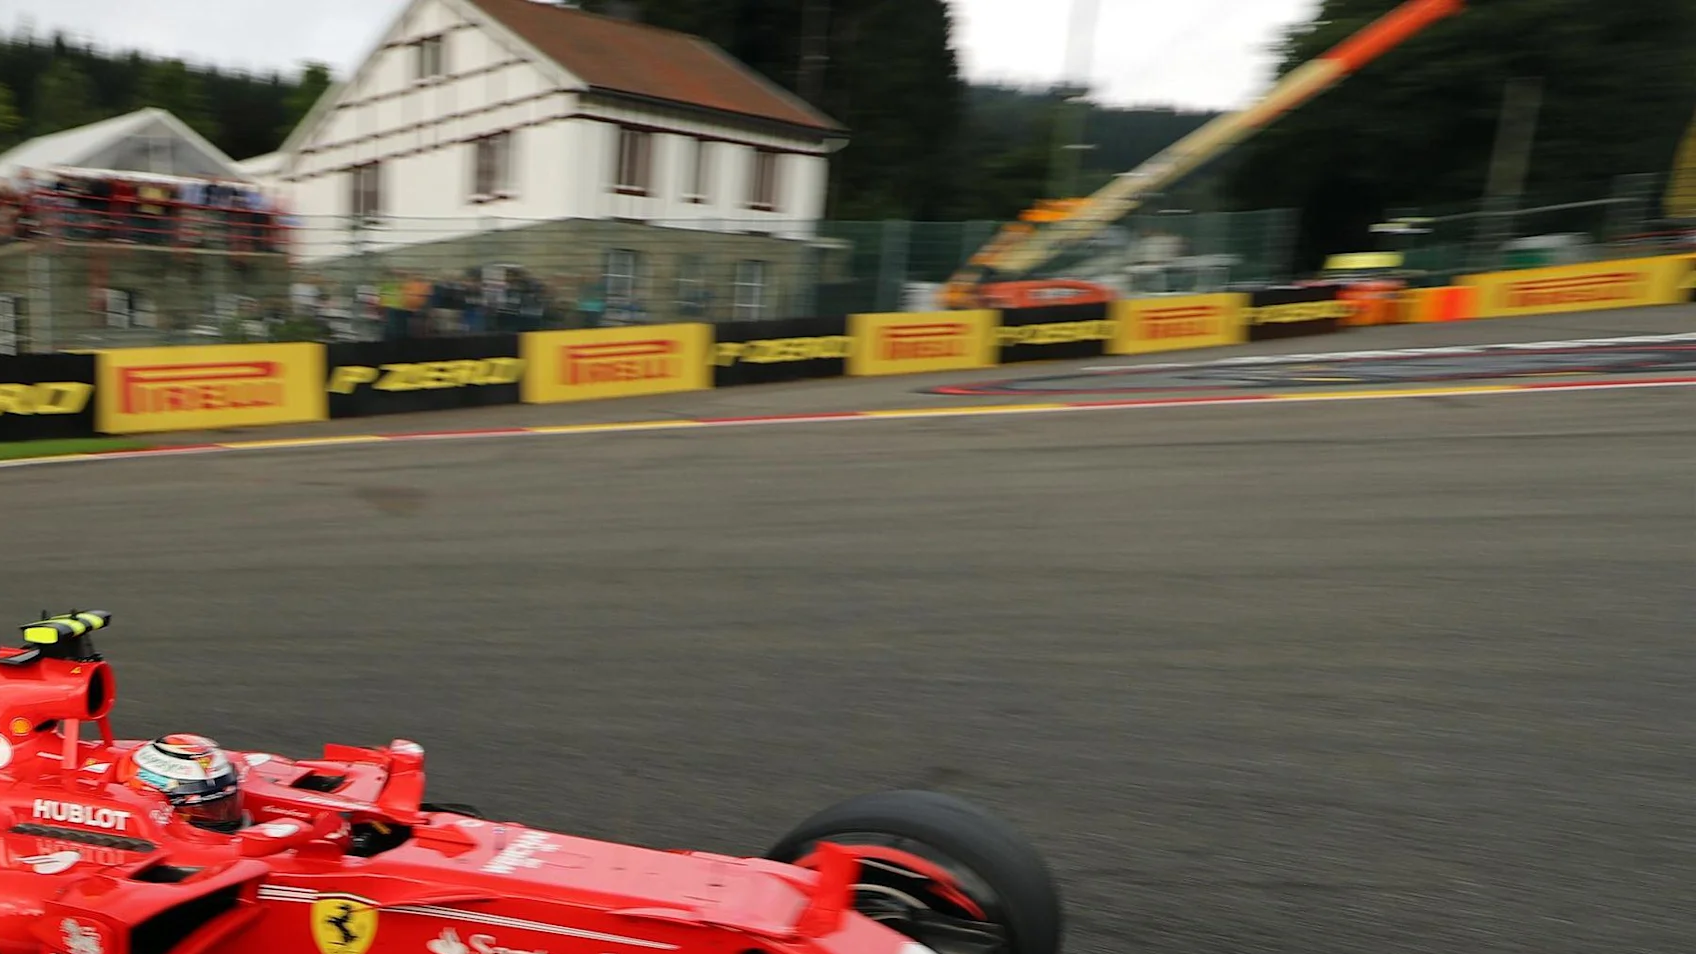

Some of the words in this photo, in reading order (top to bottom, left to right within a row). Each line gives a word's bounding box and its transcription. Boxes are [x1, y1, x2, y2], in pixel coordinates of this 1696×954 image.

[115, 361, 285, 415] PIRELLI
[327, 366, 378, 394] P
[373, 357, 525, 391] ZERO
[32, 798, 132, 831] HUBLOT
